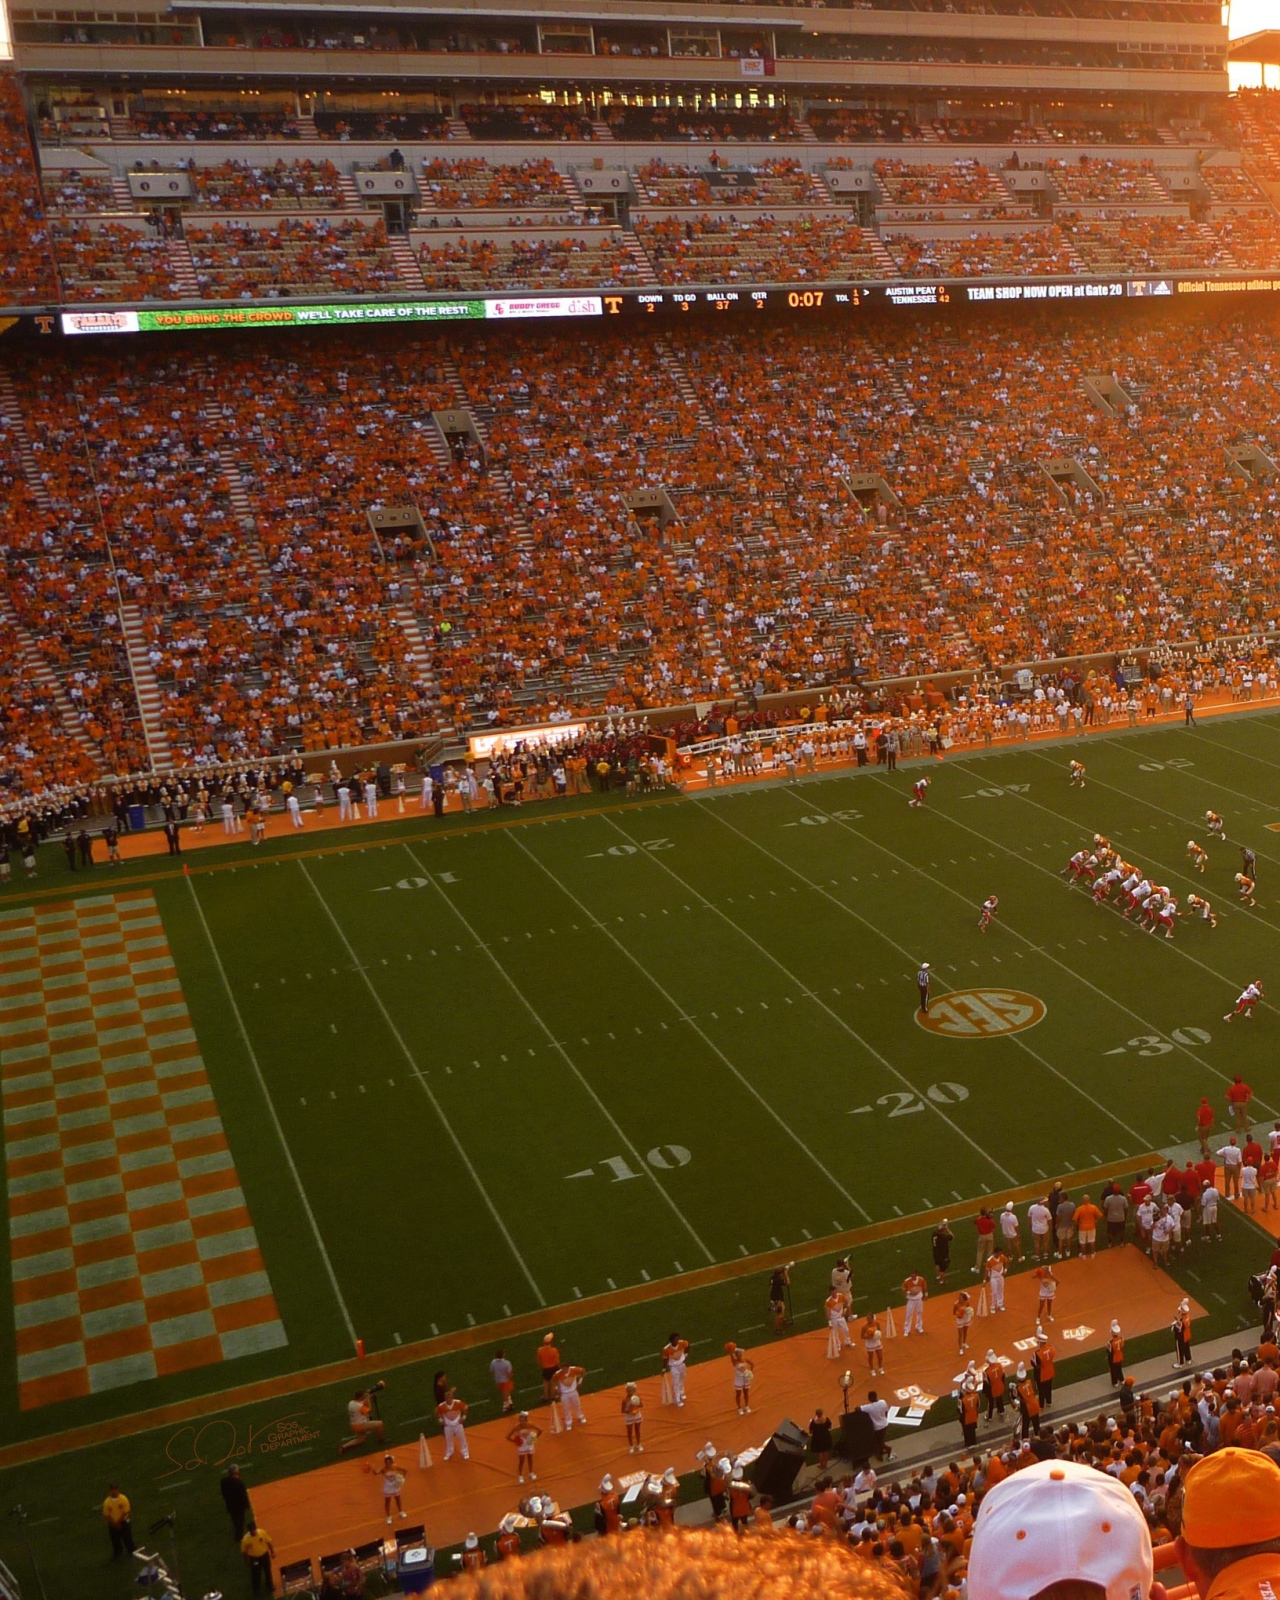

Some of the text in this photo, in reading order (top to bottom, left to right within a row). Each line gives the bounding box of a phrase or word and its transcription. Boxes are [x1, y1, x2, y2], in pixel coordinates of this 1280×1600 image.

[885, 286, 915, 296] AUSTIN
[915, 286, 936, 296] PEAY
[967, 284, 1122, 300] TEAM SHOP NOW OPEN at Gate 20
[1178, 280, 1206, 293] Official
[1206, 280, 1247, 293] Tennessee
[638, 295, 663, 303] DOWN
[673, 294, 697, 302] TO GO
[707, 292, 739, 301] BALL ON
[751, 292, 767, 300] QTR
[788, 291, 824, 308] 0:07
[835, 294, 850, 302] TOL
[891, 295, 950, 304] TENNESSEE 42
[568, 300, 596, 313] dish
[604, 297, 623, 314] T
[647, 303, 655, 312] 2
[681, 302, 689, 311] 3
[716, 301, 730, 310] 37
[756, 300, 764, 309] 2
[156, 306, 469, 325] YOU BRING THE CROWD. WE'LL TAKE CARE OF THE REST!
[34, 316, 55, 334] T
[976, 783, 1032, 798] 40
[800, 809, 864, 826] 30
[607, 838, 676, 856] 20
[396, 871, 463, 890] 10
[927, 990, 1035, 1035] SEC
[1127, 1027, 1212, 1056] 30
[876, 1082, 970, 1118] 20
[598, 1145, 692, 1183] 10
[897, 1385, 921, 1399] GO
